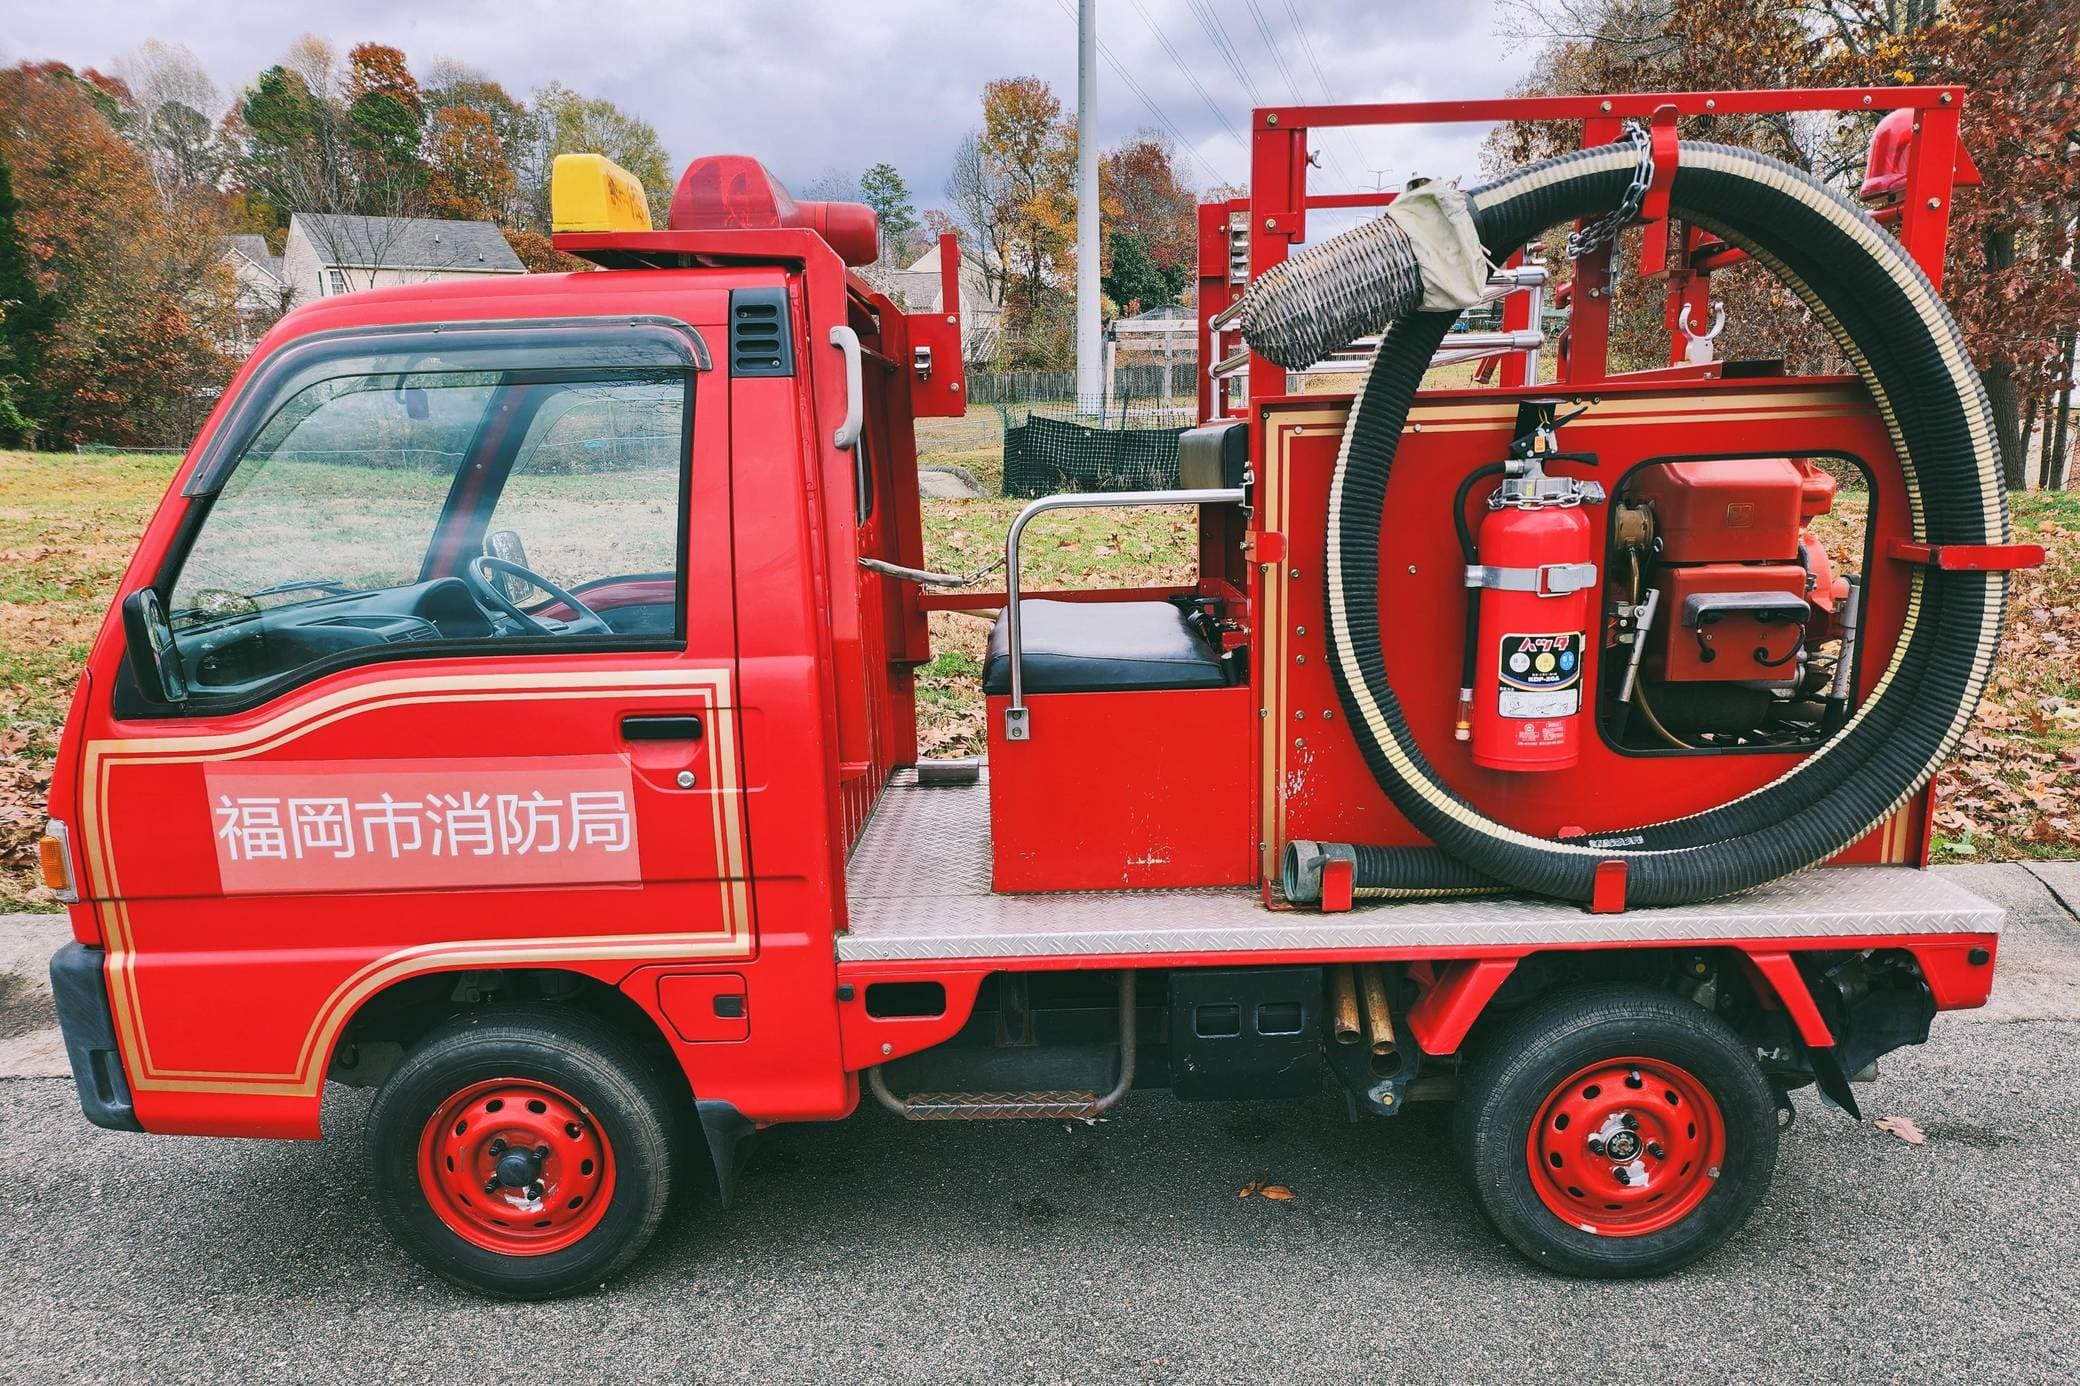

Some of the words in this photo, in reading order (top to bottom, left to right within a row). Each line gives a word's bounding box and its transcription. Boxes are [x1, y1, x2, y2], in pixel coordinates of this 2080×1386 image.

[215, 790, 630, 860] 福岡市消防局
